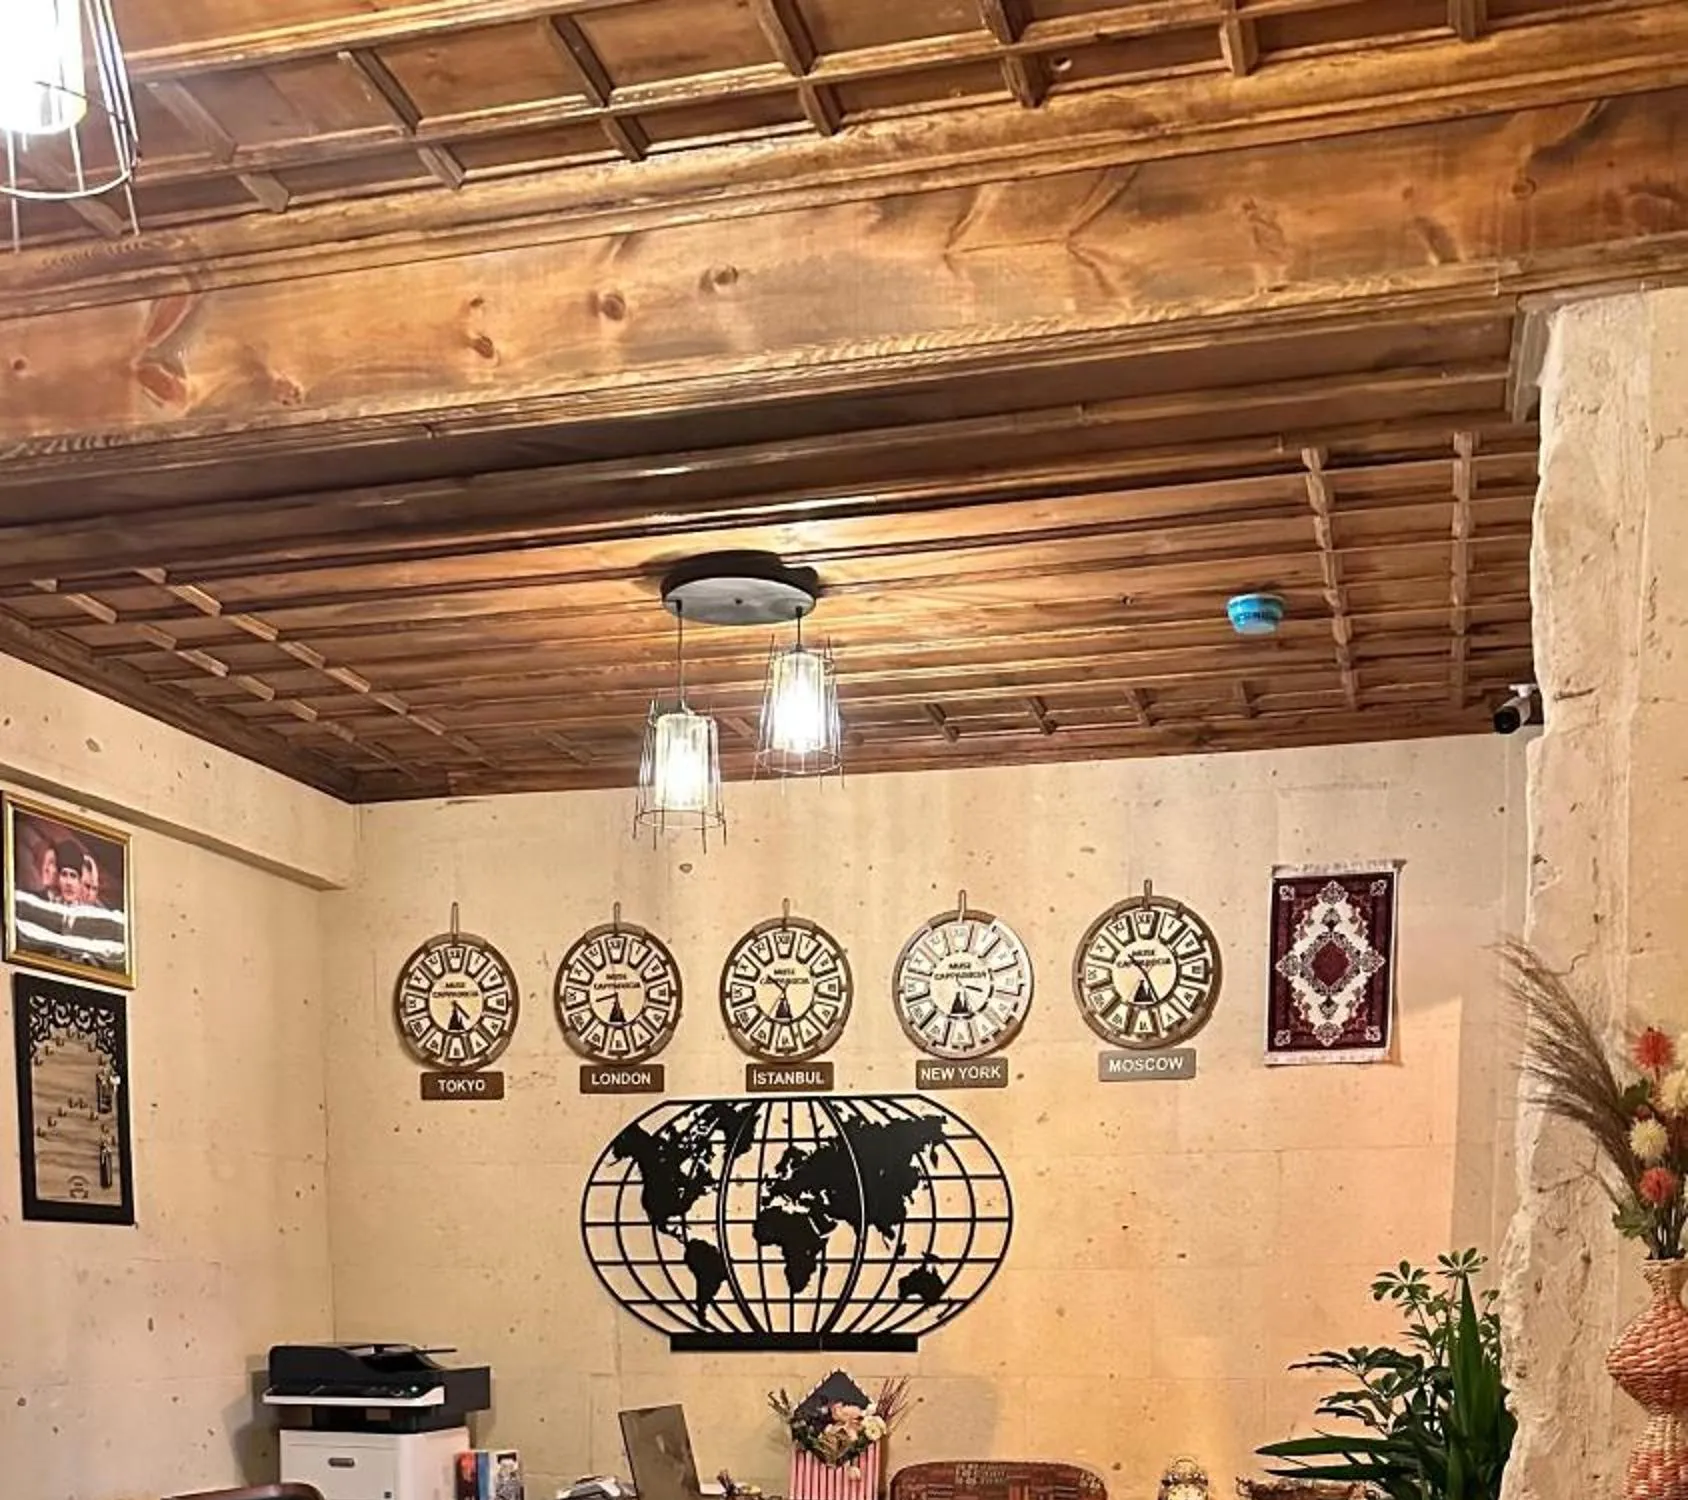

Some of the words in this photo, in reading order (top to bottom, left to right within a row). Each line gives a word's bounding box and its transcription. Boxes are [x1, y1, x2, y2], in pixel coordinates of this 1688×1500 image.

[1108, 1056, 1184, 1073] MOSCOW
[591, 1071, 651, 1085] LONDON
[752, 1069, 825, 1085] İSTANBUL
[921, 1067, 955, 1081] NEW
[958, 1065, 1001, 1080] YORK
[437, 1079, 486, 1093] TOKYO
